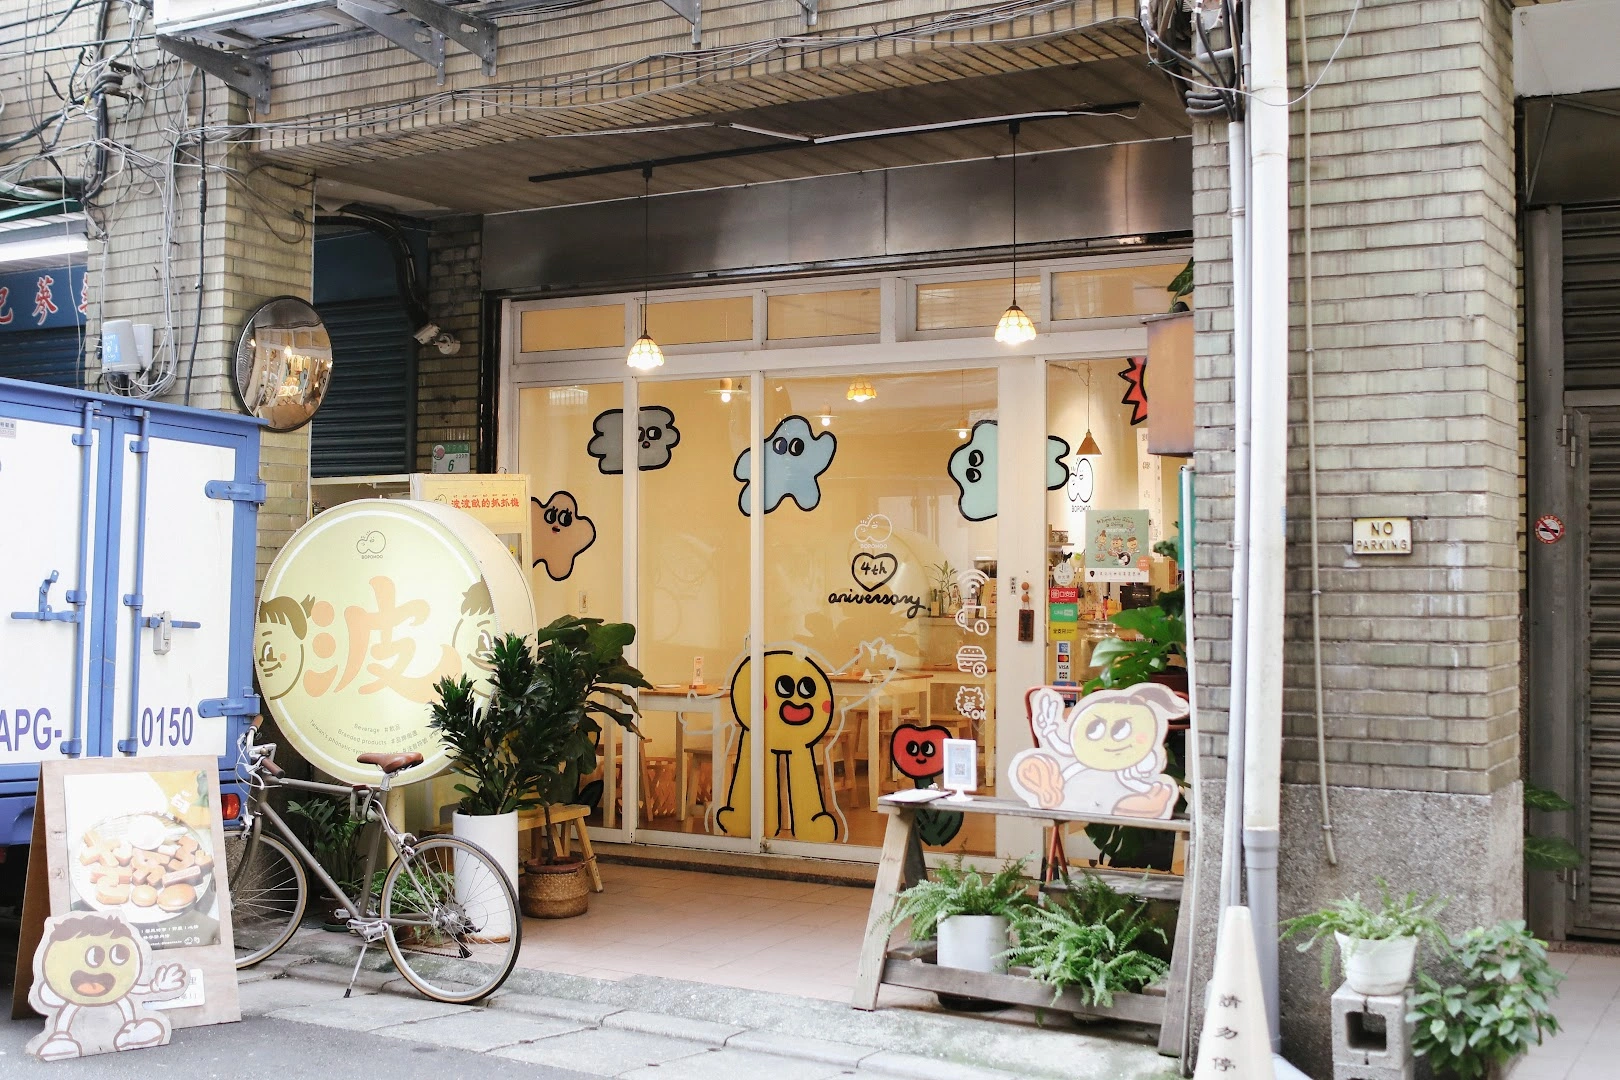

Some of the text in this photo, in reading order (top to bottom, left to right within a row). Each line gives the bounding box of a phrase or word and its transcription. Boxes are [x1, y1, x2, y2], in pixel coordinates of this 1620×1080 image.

[448, 459, 455, 472] 6
[1370, 521, 1394, 536] NO
[1356, 539, 1407, 551] PARKING
[860, 561, 888, 575] 4th
[303, 575, 462, 704] 波
[0, 706, 194, 752] APG- 0150
[310, 719, 329, 739] Taiwan's
[338, 728, 361, 742] Branded
[354, 723, 380, 734] Beverage
